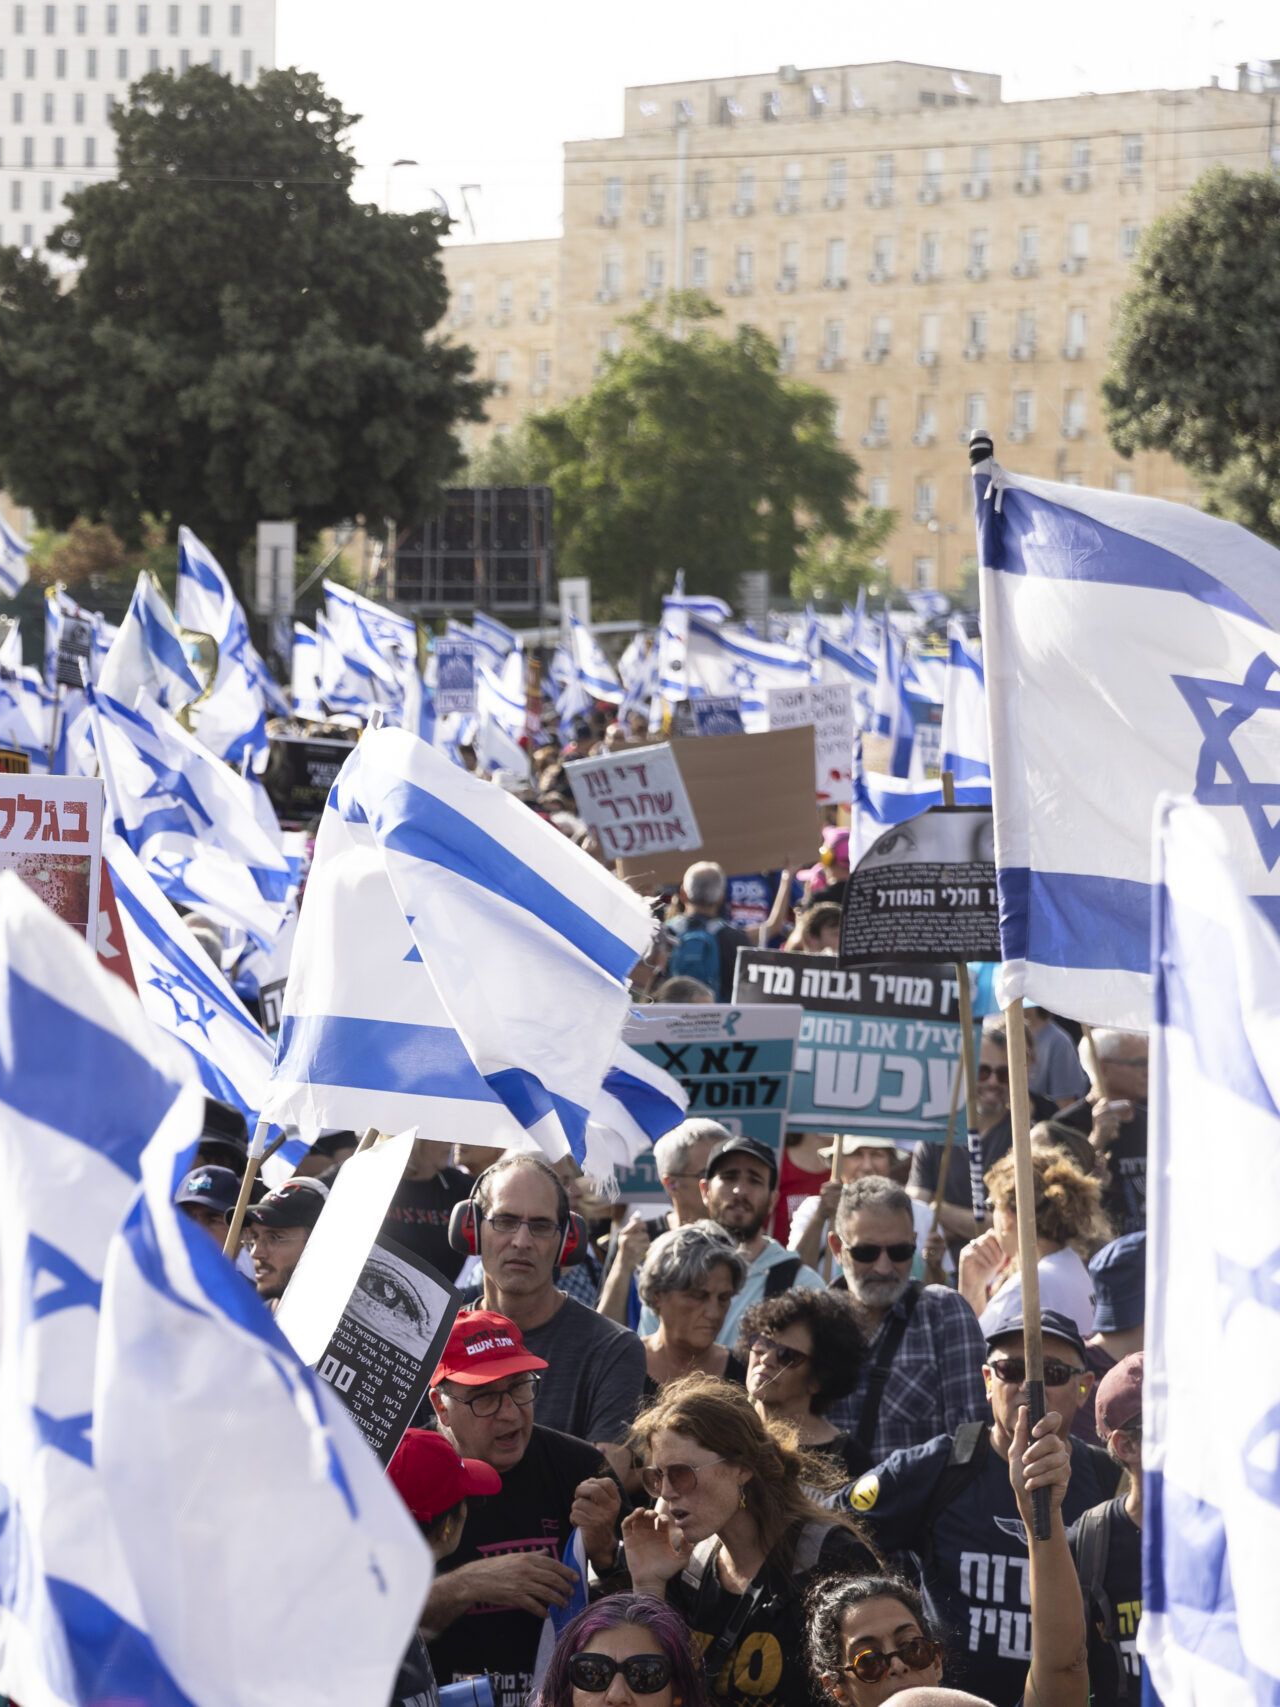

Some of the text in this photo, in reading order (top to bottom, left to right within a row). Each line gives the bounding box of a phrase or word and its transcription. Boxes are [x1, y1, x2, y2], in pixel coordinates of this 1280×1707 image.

[614, 764, 647, 788] די
[598, 791, 673, 819] שחרר
[876, 887, 936, 908] המחדל
[941, 886, 980, 907] חללי
[747, 963, 795, 996] מדי
[800, 968, 861, 1001] גבוה
[870, 973, 933, 1008] מחיר
[857, 1020, 898, 1049] את
[700, 1041, 758, 1074] לא
[355, 1323, 377, 1344] שמואל
[361, 1342, 377, 1357] ארלי
[465, 1339, 495, 1355] אשם
[337, 1341, 412, 1391] אשחר רוני אשל נועם
[379, 1354, 394, 1368] יאיר
[394, 1351, 409, 1367] ארד
[394, 1364, 416, 1382] בנימין
[382, 1393, 402, 1411] גדעון
[397, 1389, 408, 1400] לוי
[370, 1411, 393, 1430] אורטל
[384, 1407, 397, 1420] עדי
